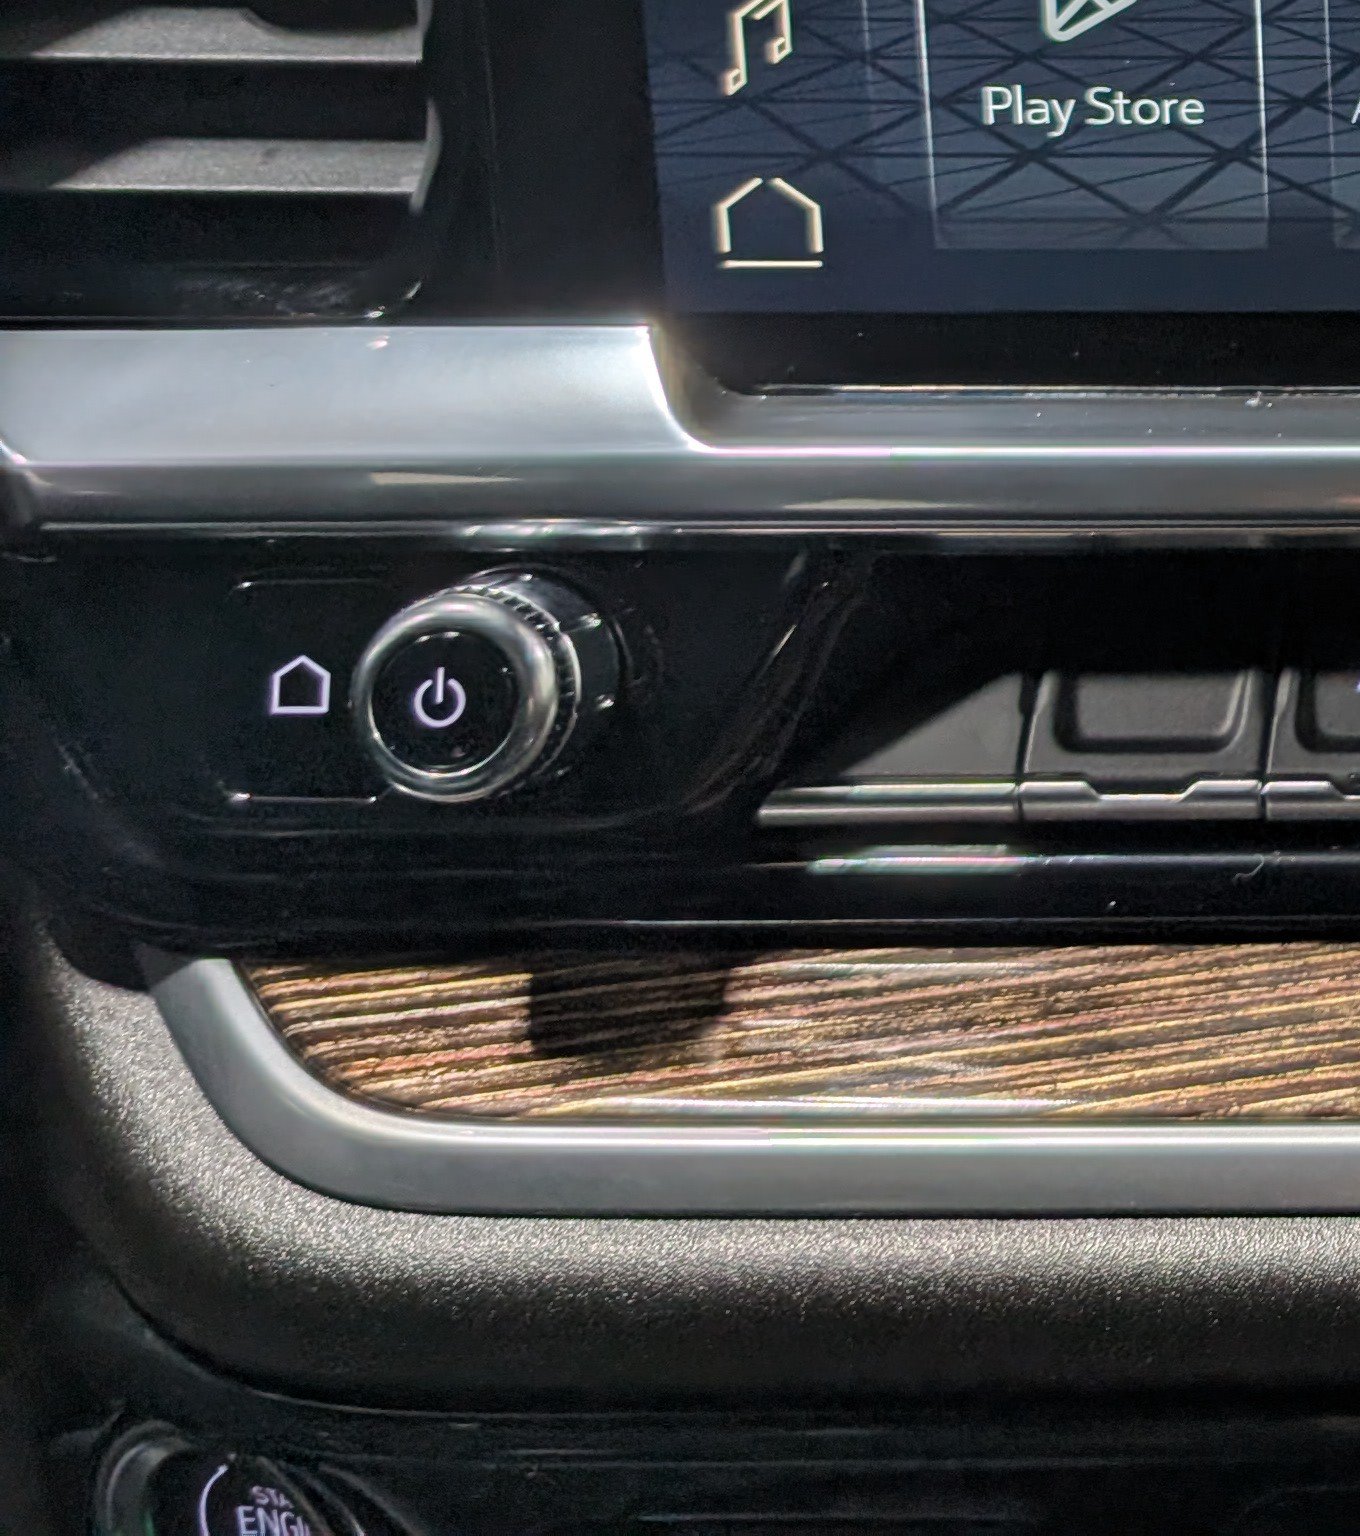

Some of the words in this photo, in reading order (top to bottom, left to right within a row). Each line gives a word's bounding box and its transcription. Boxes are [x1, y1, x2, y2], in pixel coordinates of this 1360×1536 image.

[981, 83, 1076, 138] Play
[1084, 84, 1206, 127] Store
[236, 1505, 311, 1536] ENGI
